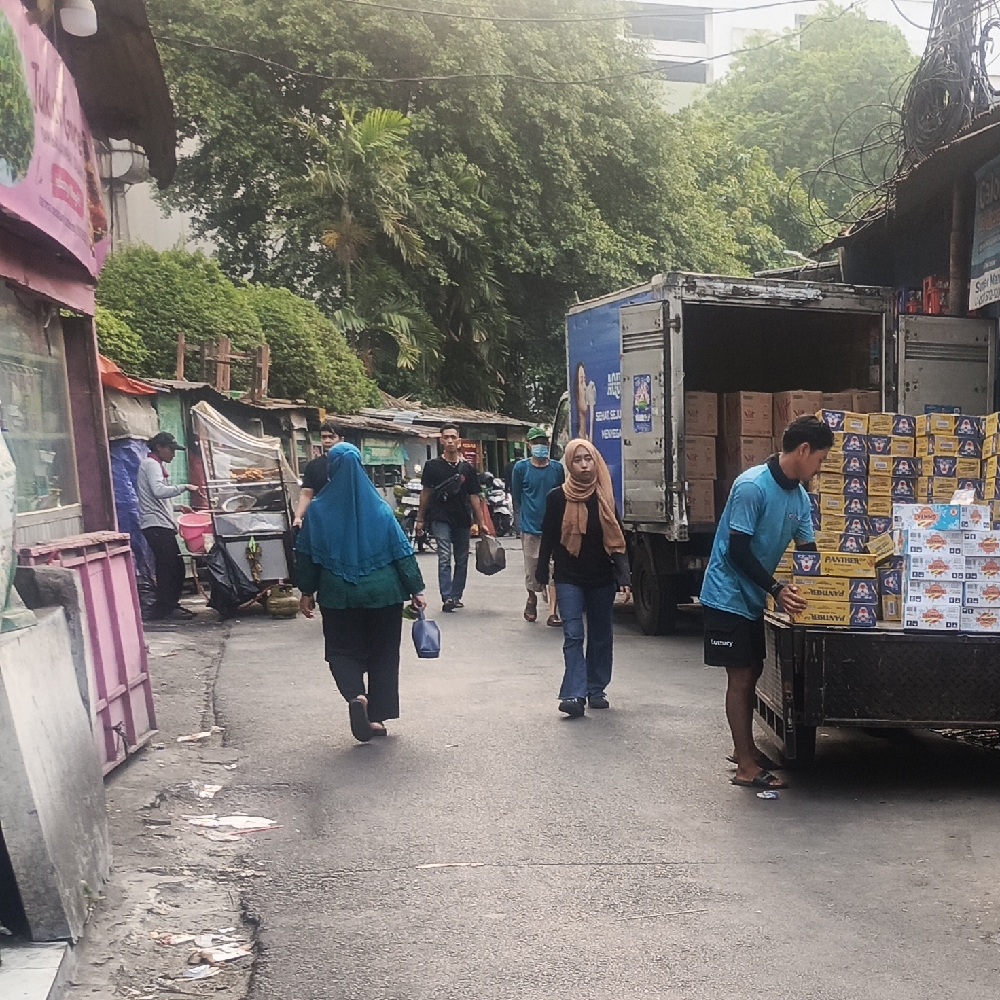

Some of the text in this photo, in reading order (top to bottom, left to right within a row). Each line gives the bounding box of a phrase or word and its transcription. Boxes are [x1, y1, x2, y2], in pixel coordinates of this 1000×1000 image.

[825, 556, 861, 565] PANTHER
[808, 588, 845, 597] PANTHER
[810, 613, 846, 622] PANTHER
